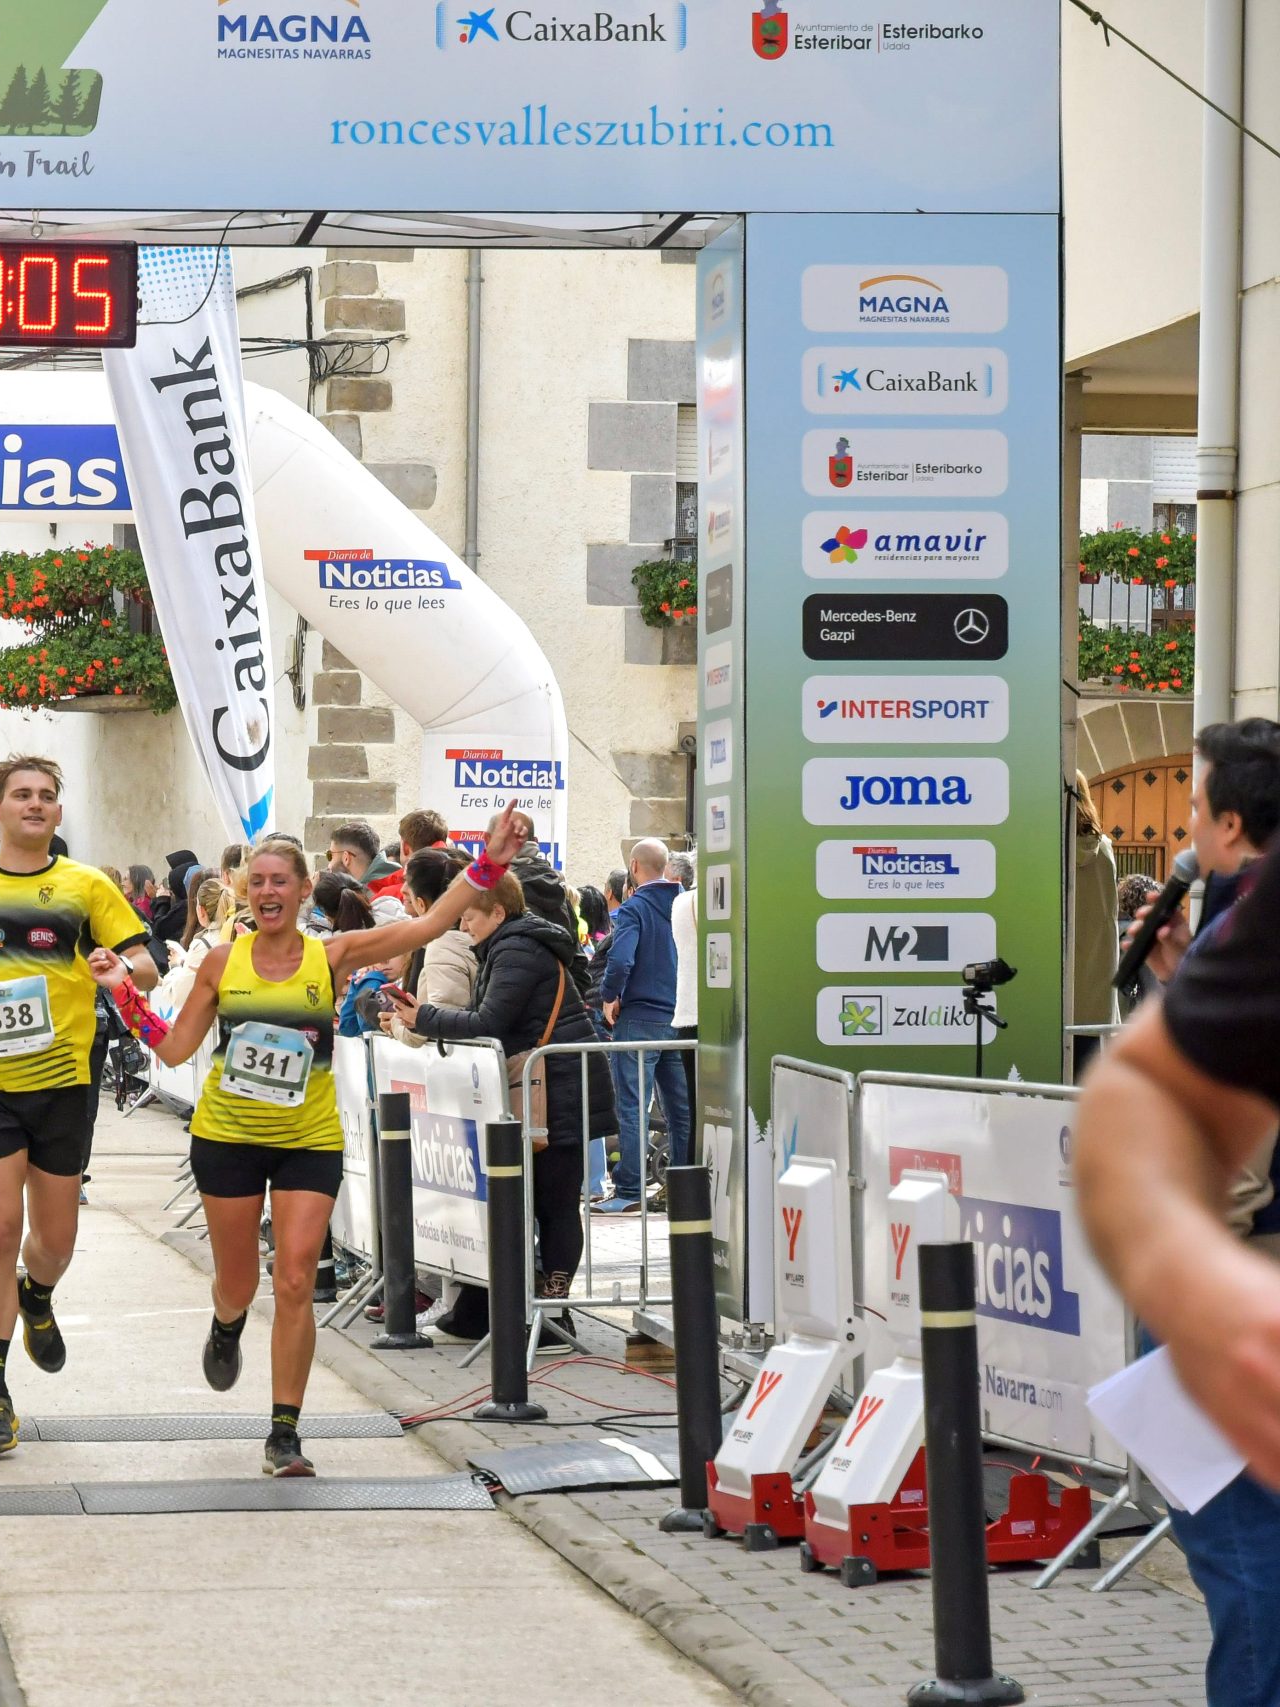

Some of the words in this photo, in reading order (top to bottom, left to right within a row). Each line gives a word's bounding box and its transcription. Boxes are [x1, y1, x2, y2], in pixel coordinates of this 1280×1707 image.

[218, 15, 370, 43] MAGNA
[505, 10, 667, 44] CaixaBank
[795, 23, 856, 33] Ayuntamiento
[860, 23, 874, 32] de
[883, 24, 984, 40] Esteribarko
[794, 34, 872, 50] Esteribar
[883, 42, 910, 51] Udala
[218, 48, 299, 59] MAGNESITAS
[303, 49, 371, 60] NAVARRAS
[331, 104, 834, 148] roncesvalleszubiri.com
[24, 149, 95, 178] Trail
[859, 296, 950, 313] MAGNA
[866, 370, 978, 391] CaixaBank
[857, 470, 908, 481] Esteribar
[915, 463, 983, 474] Esteribarko
[874, 528, 987, 552] amavir
[150, 336, 270, 772] CaixaBank
[327, 551, 358, 560] Diario
[360, 551, 371, 559] de
[945, 554, 981, 562] mayores
[324, 561, 444, 588] Noticias
[329, 595, 360, 609] Eres
[366, 596, 379, 609] lo
[384, 599, 412, 614] que
[418, 595, 445, 609] lees
[820, 609, 917, 622] Mercedes-Benz
[820, 628, 856, 643] Gazpi
[841, 700, 990, 719] INTERSPORT
[462, 750, 489, 760] Diario
[491, 750, 501, 759] de
[461, 794, 489, 808] Eres
[494, 794, 505, 808] lo
[538, 795, 552, 809] lee
[865, 855, 946, 874] Noticias
[867, 879, 889, 889] Eres
[892, 879, 901, 889] lo
[905, 881, 923, 892] que
[926, 879, 945, 889] lees
[30, 931, 54, 943] BENIS
[864, 926, 918, 961] M2
[243, 1047, 291, 1078] 341
[411, 1118, 477, 1194] Noticias
[964, 1210, 1052, 1319] icias
[986, 1364, 1063, 1413] Navarra.com
